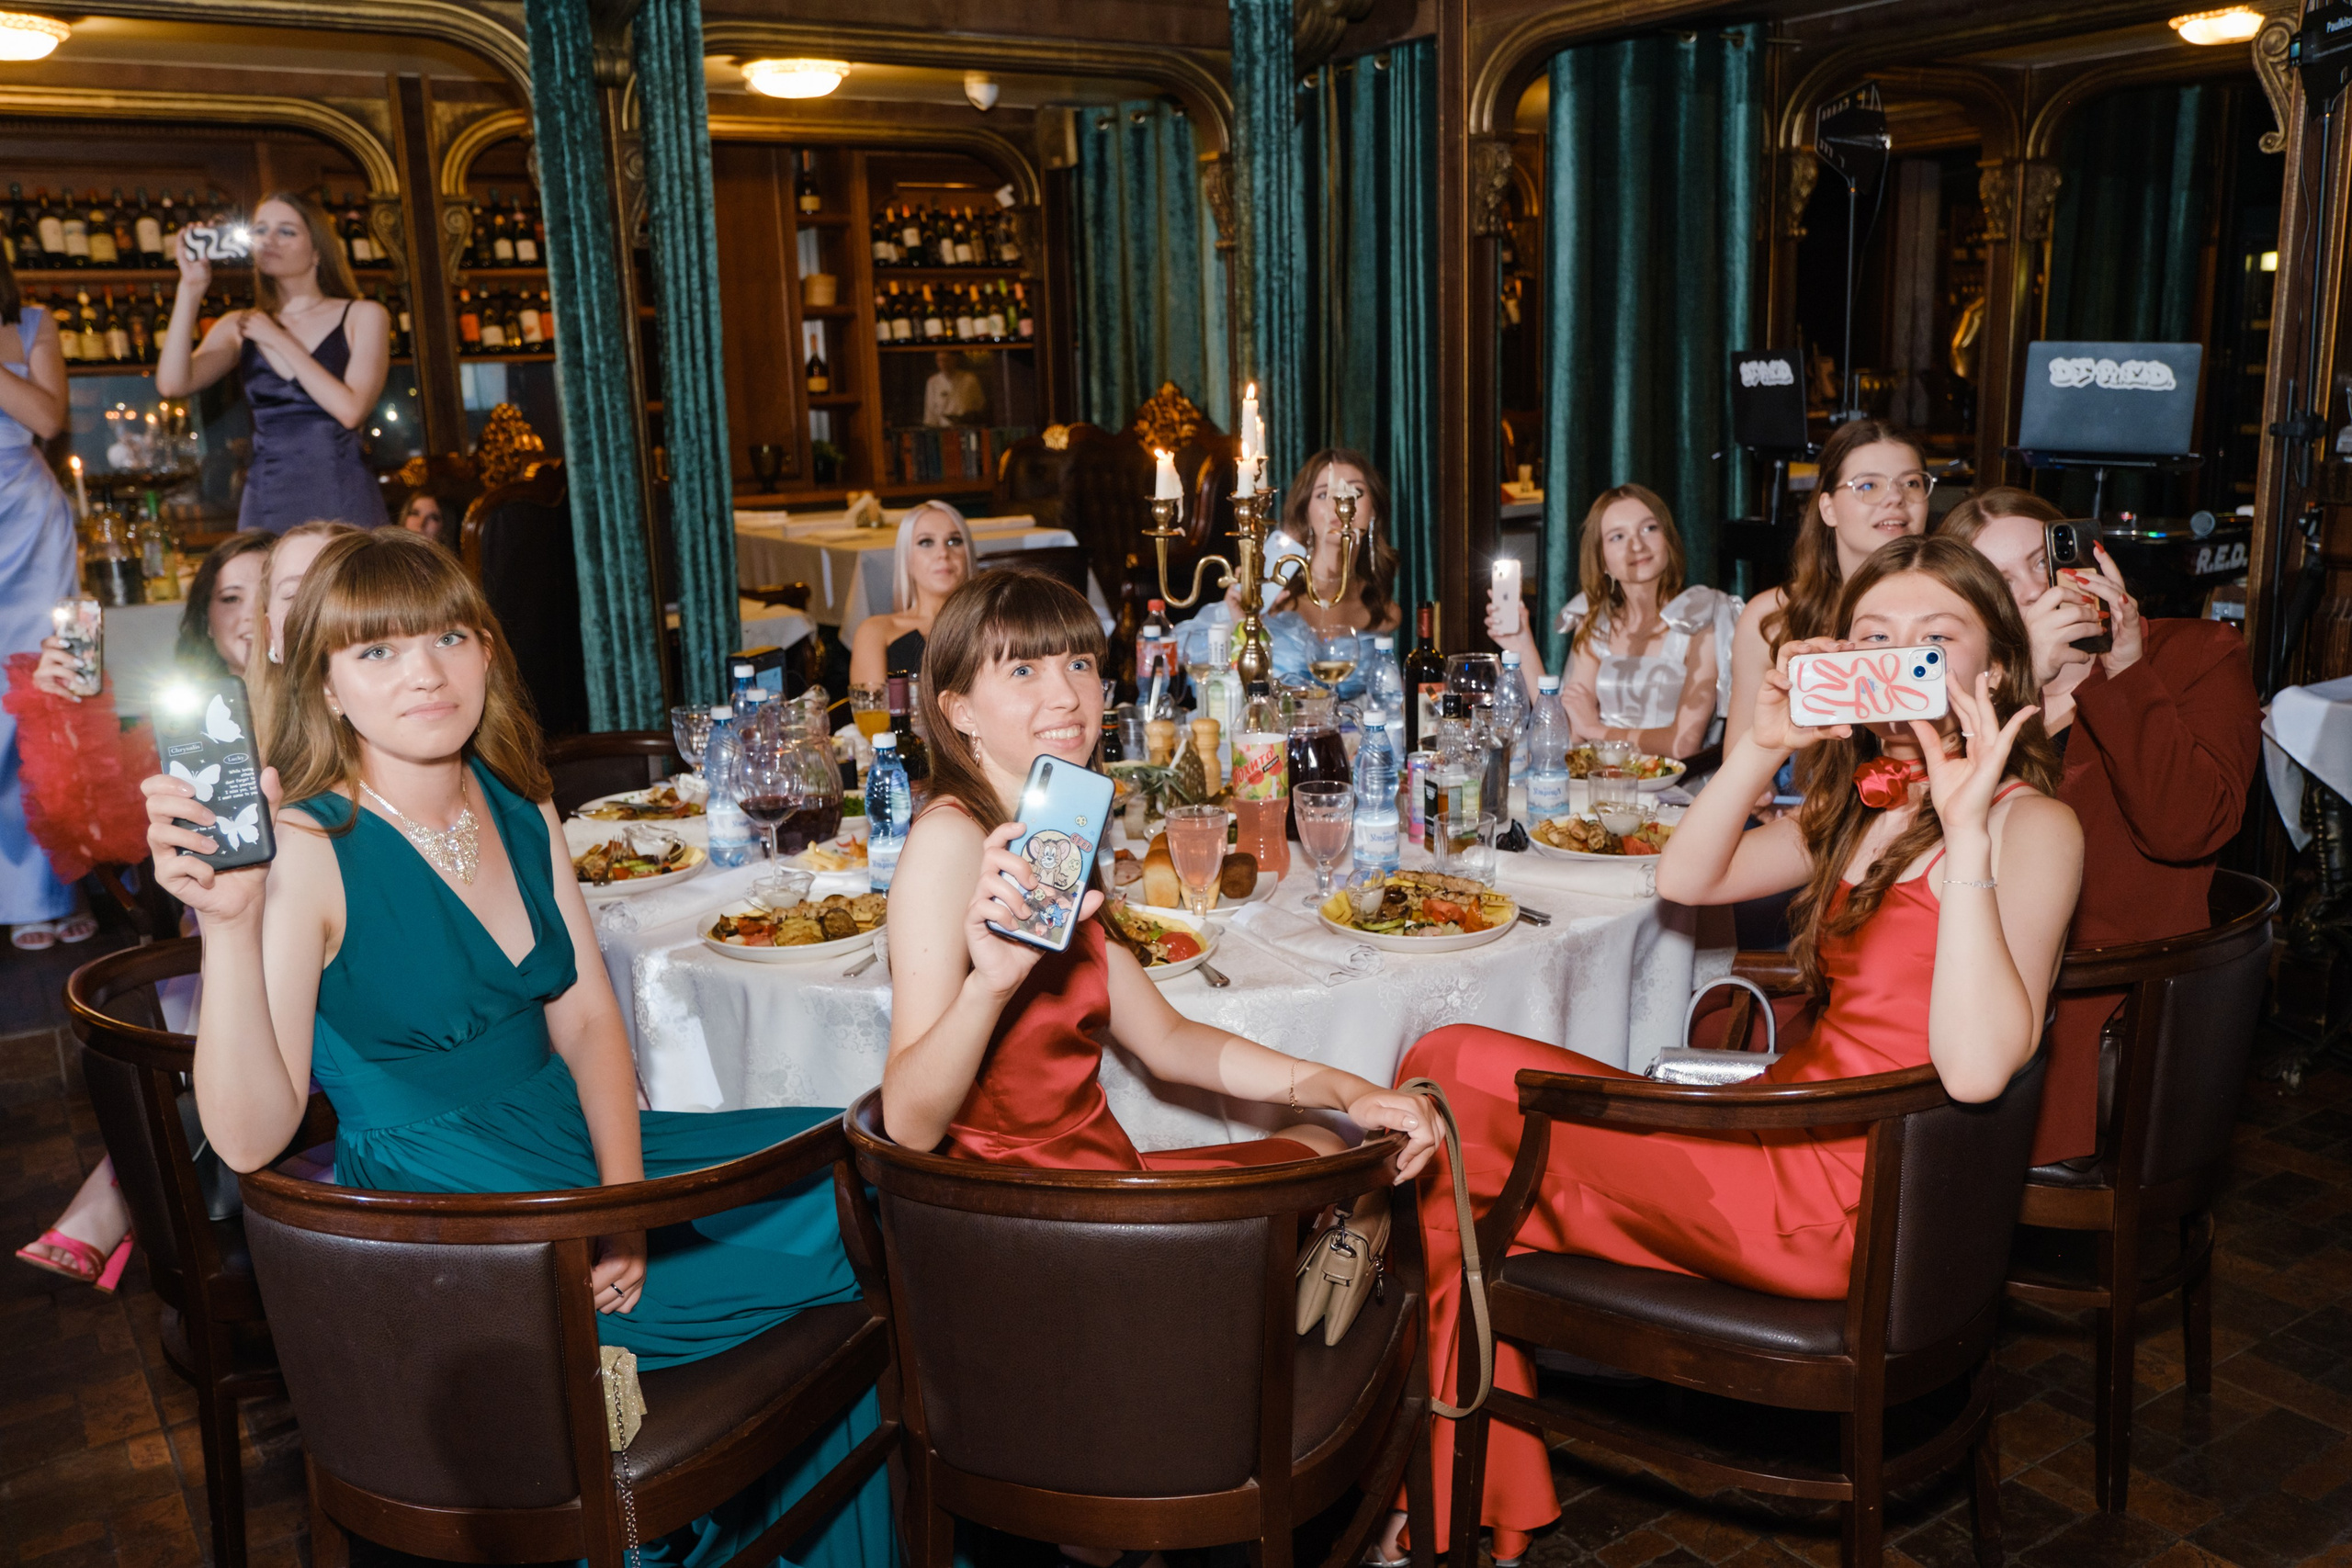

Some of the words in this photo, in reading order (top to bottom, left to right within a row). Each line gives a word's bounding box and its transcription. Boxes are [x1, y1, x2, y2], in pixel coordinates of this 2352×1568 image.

[2195, 542, 2248, 576] R.E.D.
[170, 744, 201, 754] Chrysalis
[1069, 832, 1093, 853] GOOD
